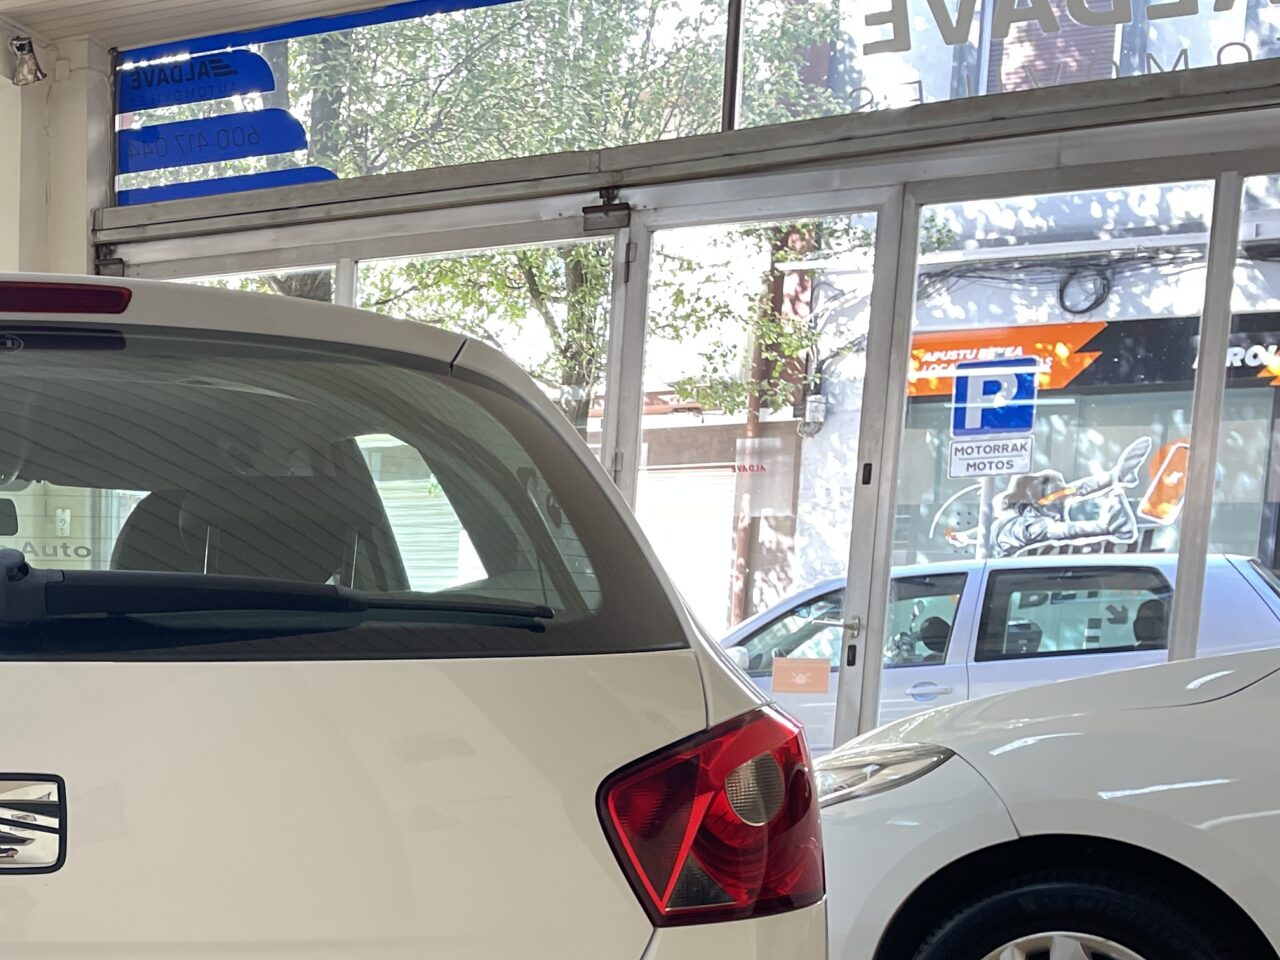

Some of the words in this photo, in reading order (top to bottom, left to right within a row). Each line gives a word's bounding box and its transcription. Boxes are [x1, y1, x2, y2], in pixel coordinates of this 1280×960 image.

[921, 348, 977, 361] APUSTU
[965, 371, 1018, 429] P
[954, 442, 1028, 457] MOTORRAK
[966, 460, 1014, 472] MOTOS
[21, 541, 92, 558] Auto
